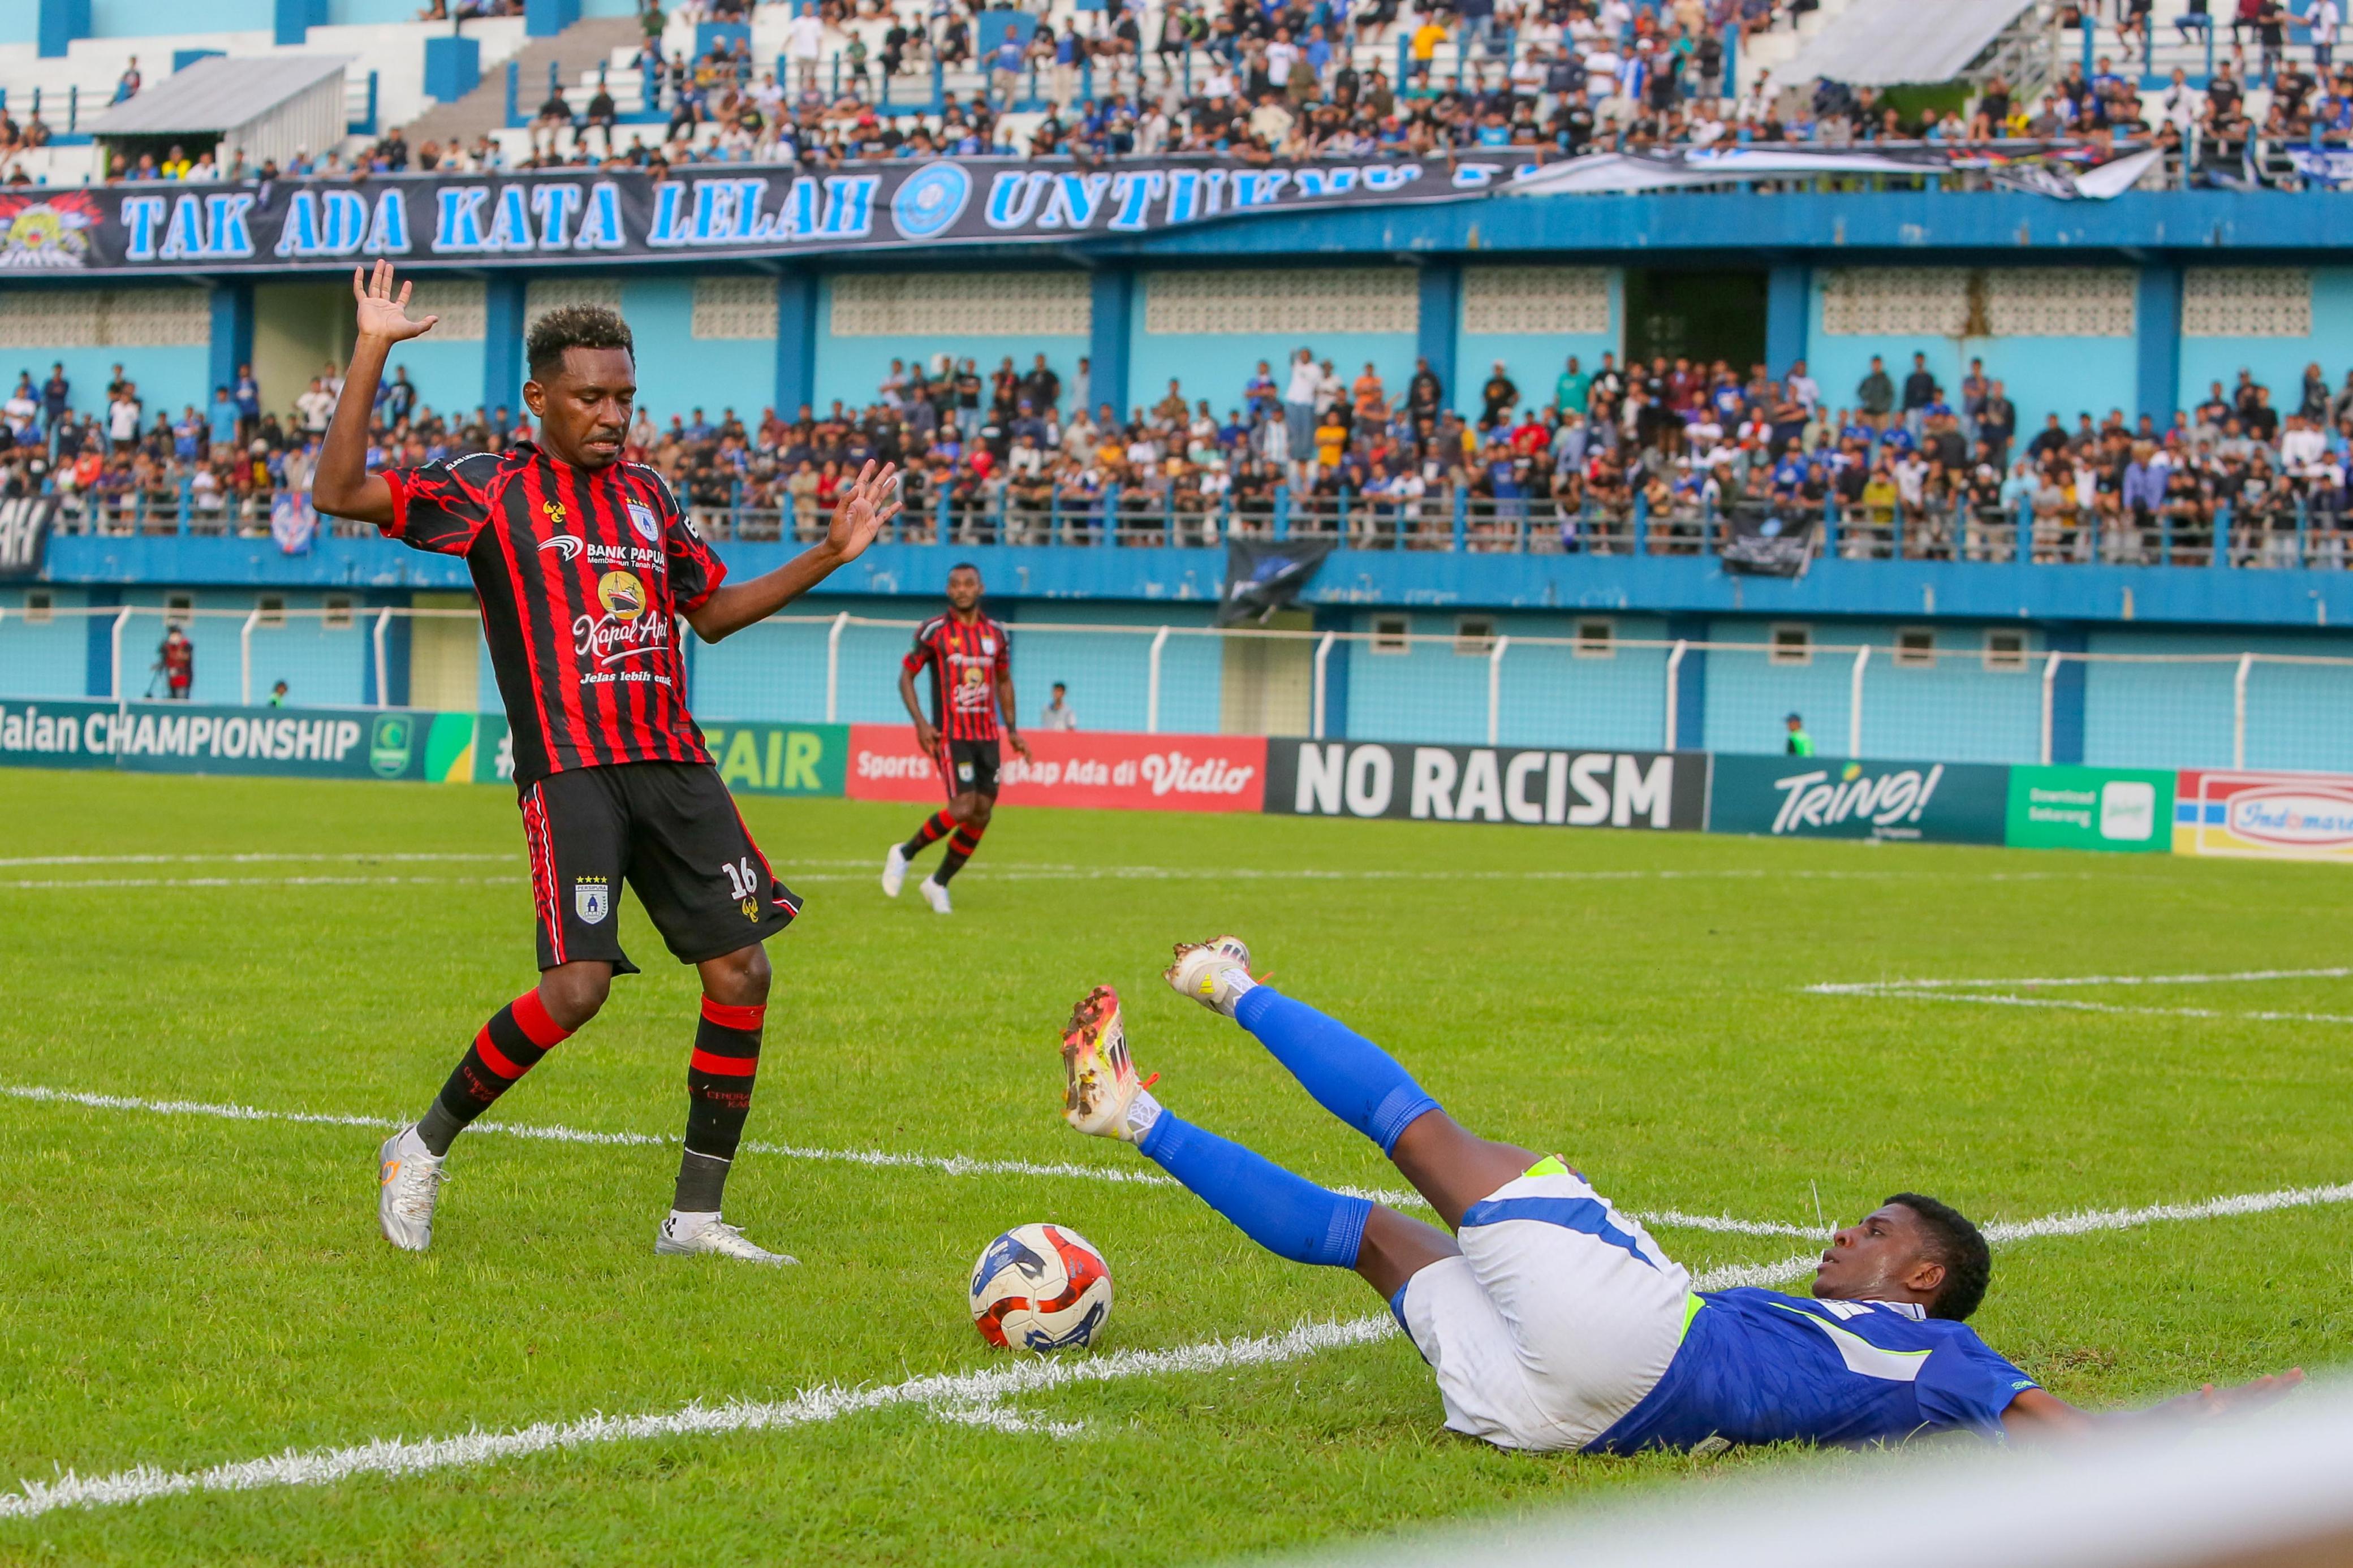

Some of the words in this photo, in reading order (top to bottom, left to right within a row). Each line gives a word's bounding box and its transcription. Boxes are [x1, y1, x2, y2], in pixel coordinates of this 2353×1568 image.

[120, 192, 255, 261] TAK
[274, 188, 412, 257] ADA
[431, 181, 627, 253] KATA
[647, 173, 881, 247] LELAH
[587, 543, 627, 559] BANK
[630, 547, 665, 566] PAPUA
[631, 560, 650, 569] Tanah
[572, 612, 638, 657] Kapal
[639, 610, 668, 646] Api
[580, 671, 616, 684] Jelas
[620, 671, 651, 681] lebih
[654, 675, 672, 687] enak
[84, 712, 362, 762] CHAMPIONSHIP
[857, 750, 930, 780] Sports
[1063, 758, 1109, 786] Ada
[1112, 759, 1137, 787] di
[1140, 751, 1256, 796] Vidio
[1295, 742, 1394, 818] NO
[1410, 746, 1674, 830] RACISM
[722, 856, 758, 900] 16
